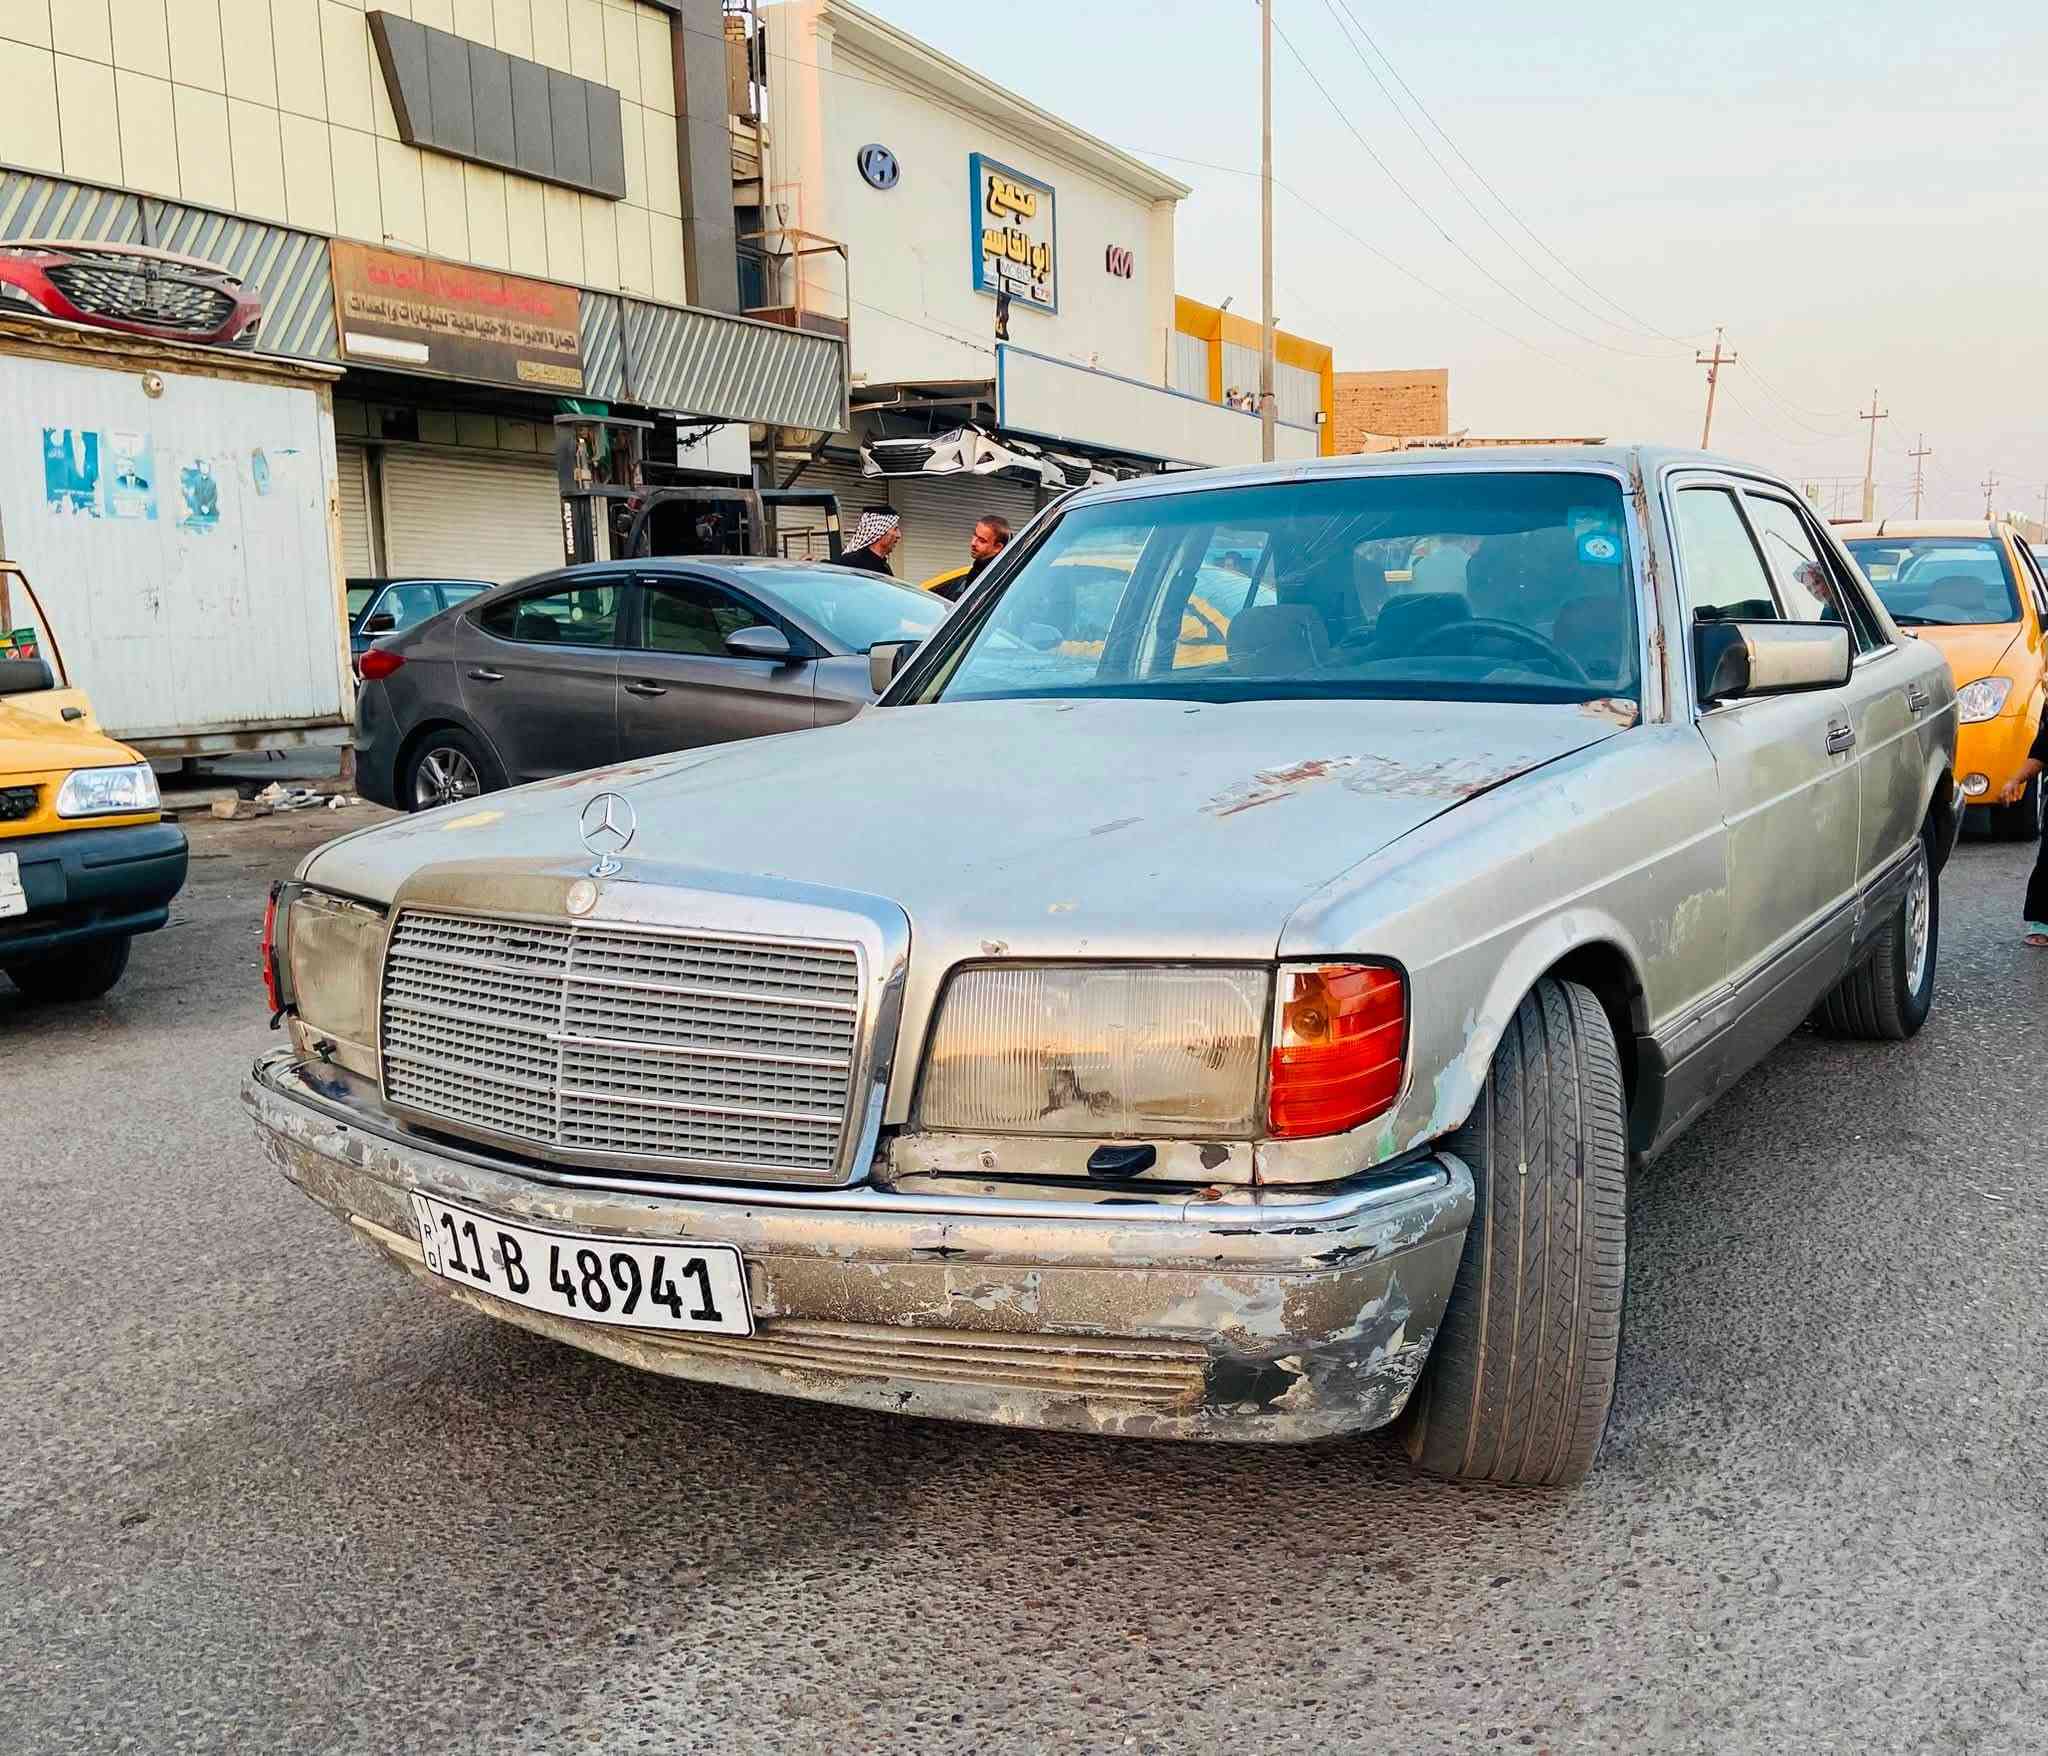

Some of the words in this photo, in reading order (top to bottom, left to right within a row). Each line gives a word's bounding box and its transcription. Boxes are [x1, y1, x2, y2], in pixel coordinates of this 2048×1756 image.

[988, 176, 1036, 224] مجمع
[1000, 263, 1031, 282] MOBIS
[351, 297, 398, 321] والمعدات
[400, 304, 449, 328] للسيارات
[548, 330, 577, 350] تجارة
[441, 1212, 491, 1282] 11
[497, 1231, 530, 1294] B
[549, 1245, 723, 1322] 48941
